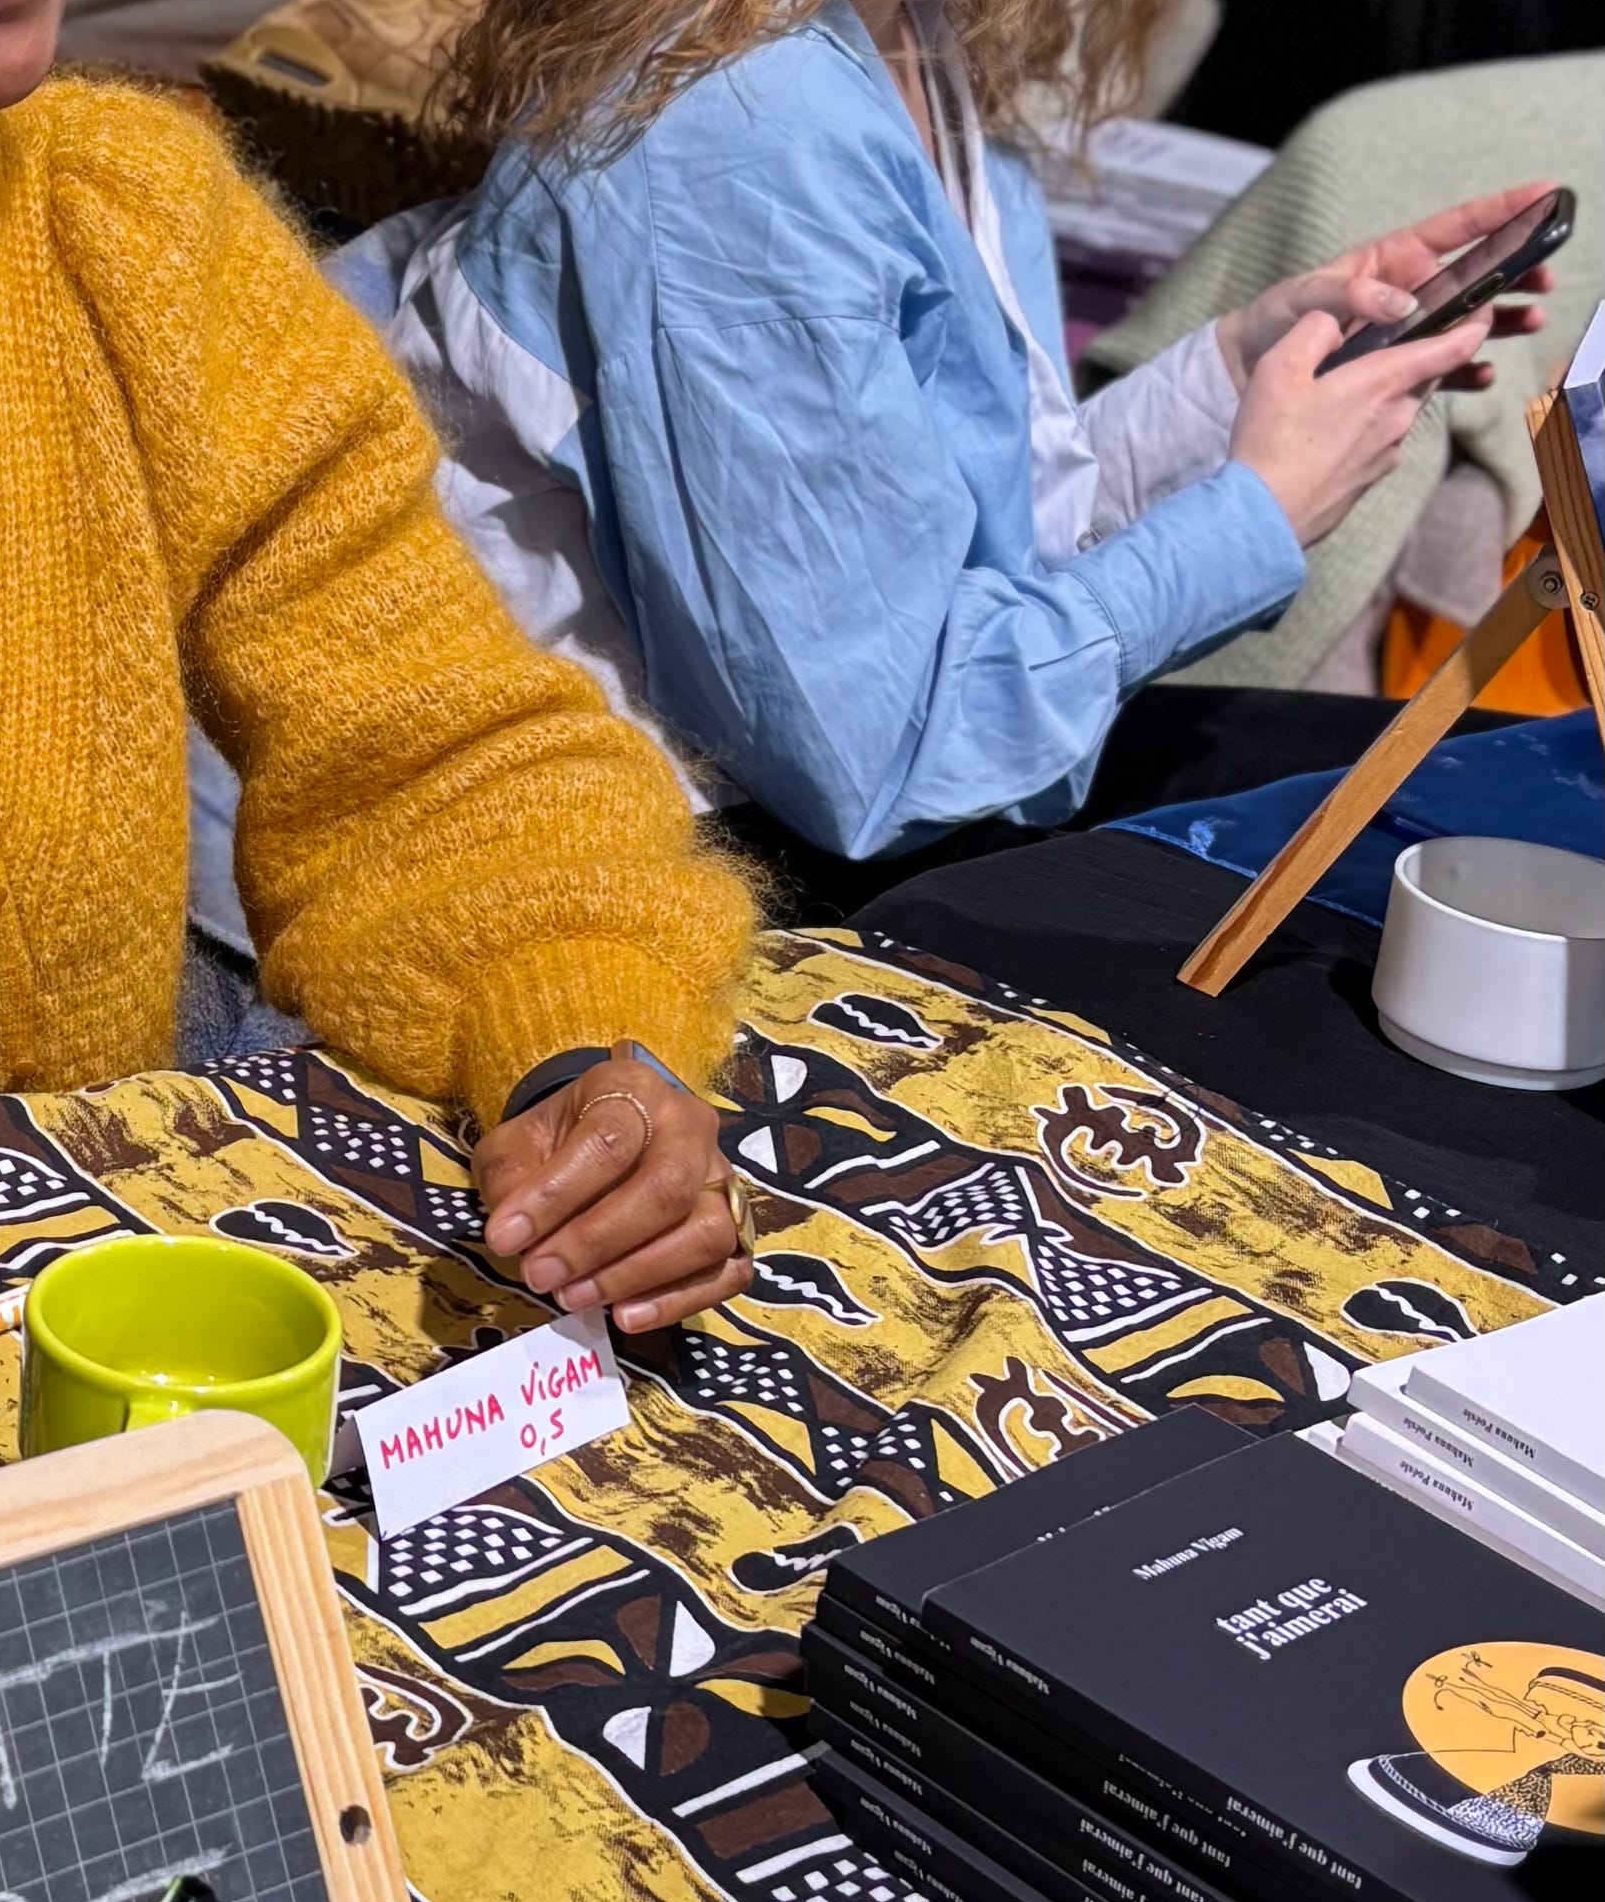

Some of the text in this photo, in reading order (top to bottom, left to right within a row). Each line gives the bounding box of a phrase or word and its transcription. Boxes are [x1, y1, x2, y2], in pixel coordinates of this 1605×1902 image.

[380, 1393, 505, 1470] MAHUNA
[1495, 1427, 1537, 1459] Mahuna
[1434, 1435, 1475, 1467] Mahuna
[1433, 1479, 1475, 1511] Mahuna
[1132, 1527, 1244, 1581] Mahuna Vigam
[1216, 1578, 1332, 1634] tant que
[1236, 1588, 1368, 1661] j'aimerai
[1171, 1822, 1199, 1847] que
[1202, 1841, 1231, 1868] tant
[1299, 1841, 1328, 1867] que
[1146, 1862, 1173, 1885] que
[1331, 1862, 1362, 1889] tant
